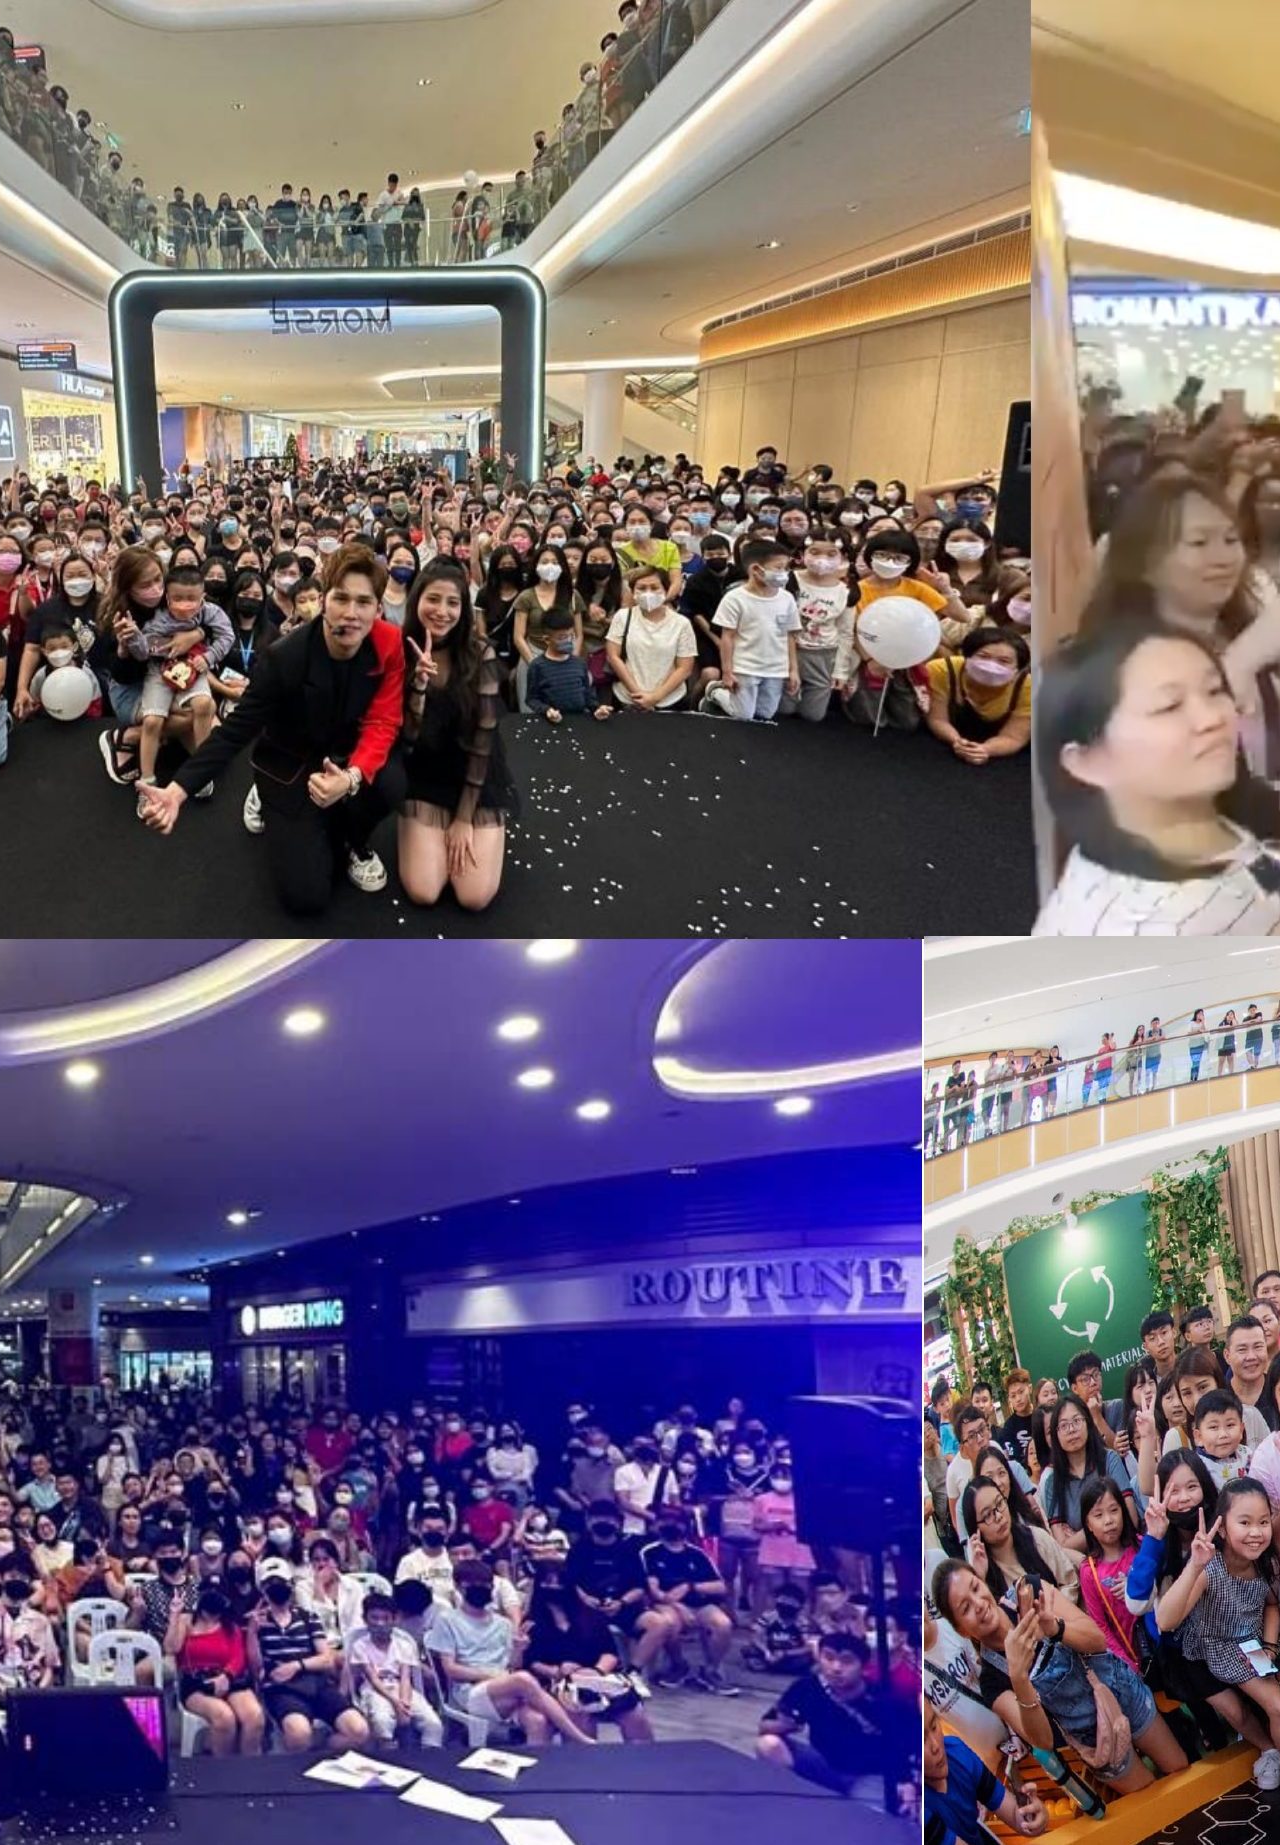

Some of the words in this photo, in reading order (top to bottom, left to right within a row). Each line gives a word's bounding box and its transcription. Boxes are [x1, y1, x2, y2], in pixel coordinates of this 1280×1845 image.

[61, 373, 84, 395] HLA
[624, 1257, 908, 1306] ROUTINE
[259, 1303, 305, 1330] BURGER
[306, 1299, 344, 1328] KING
